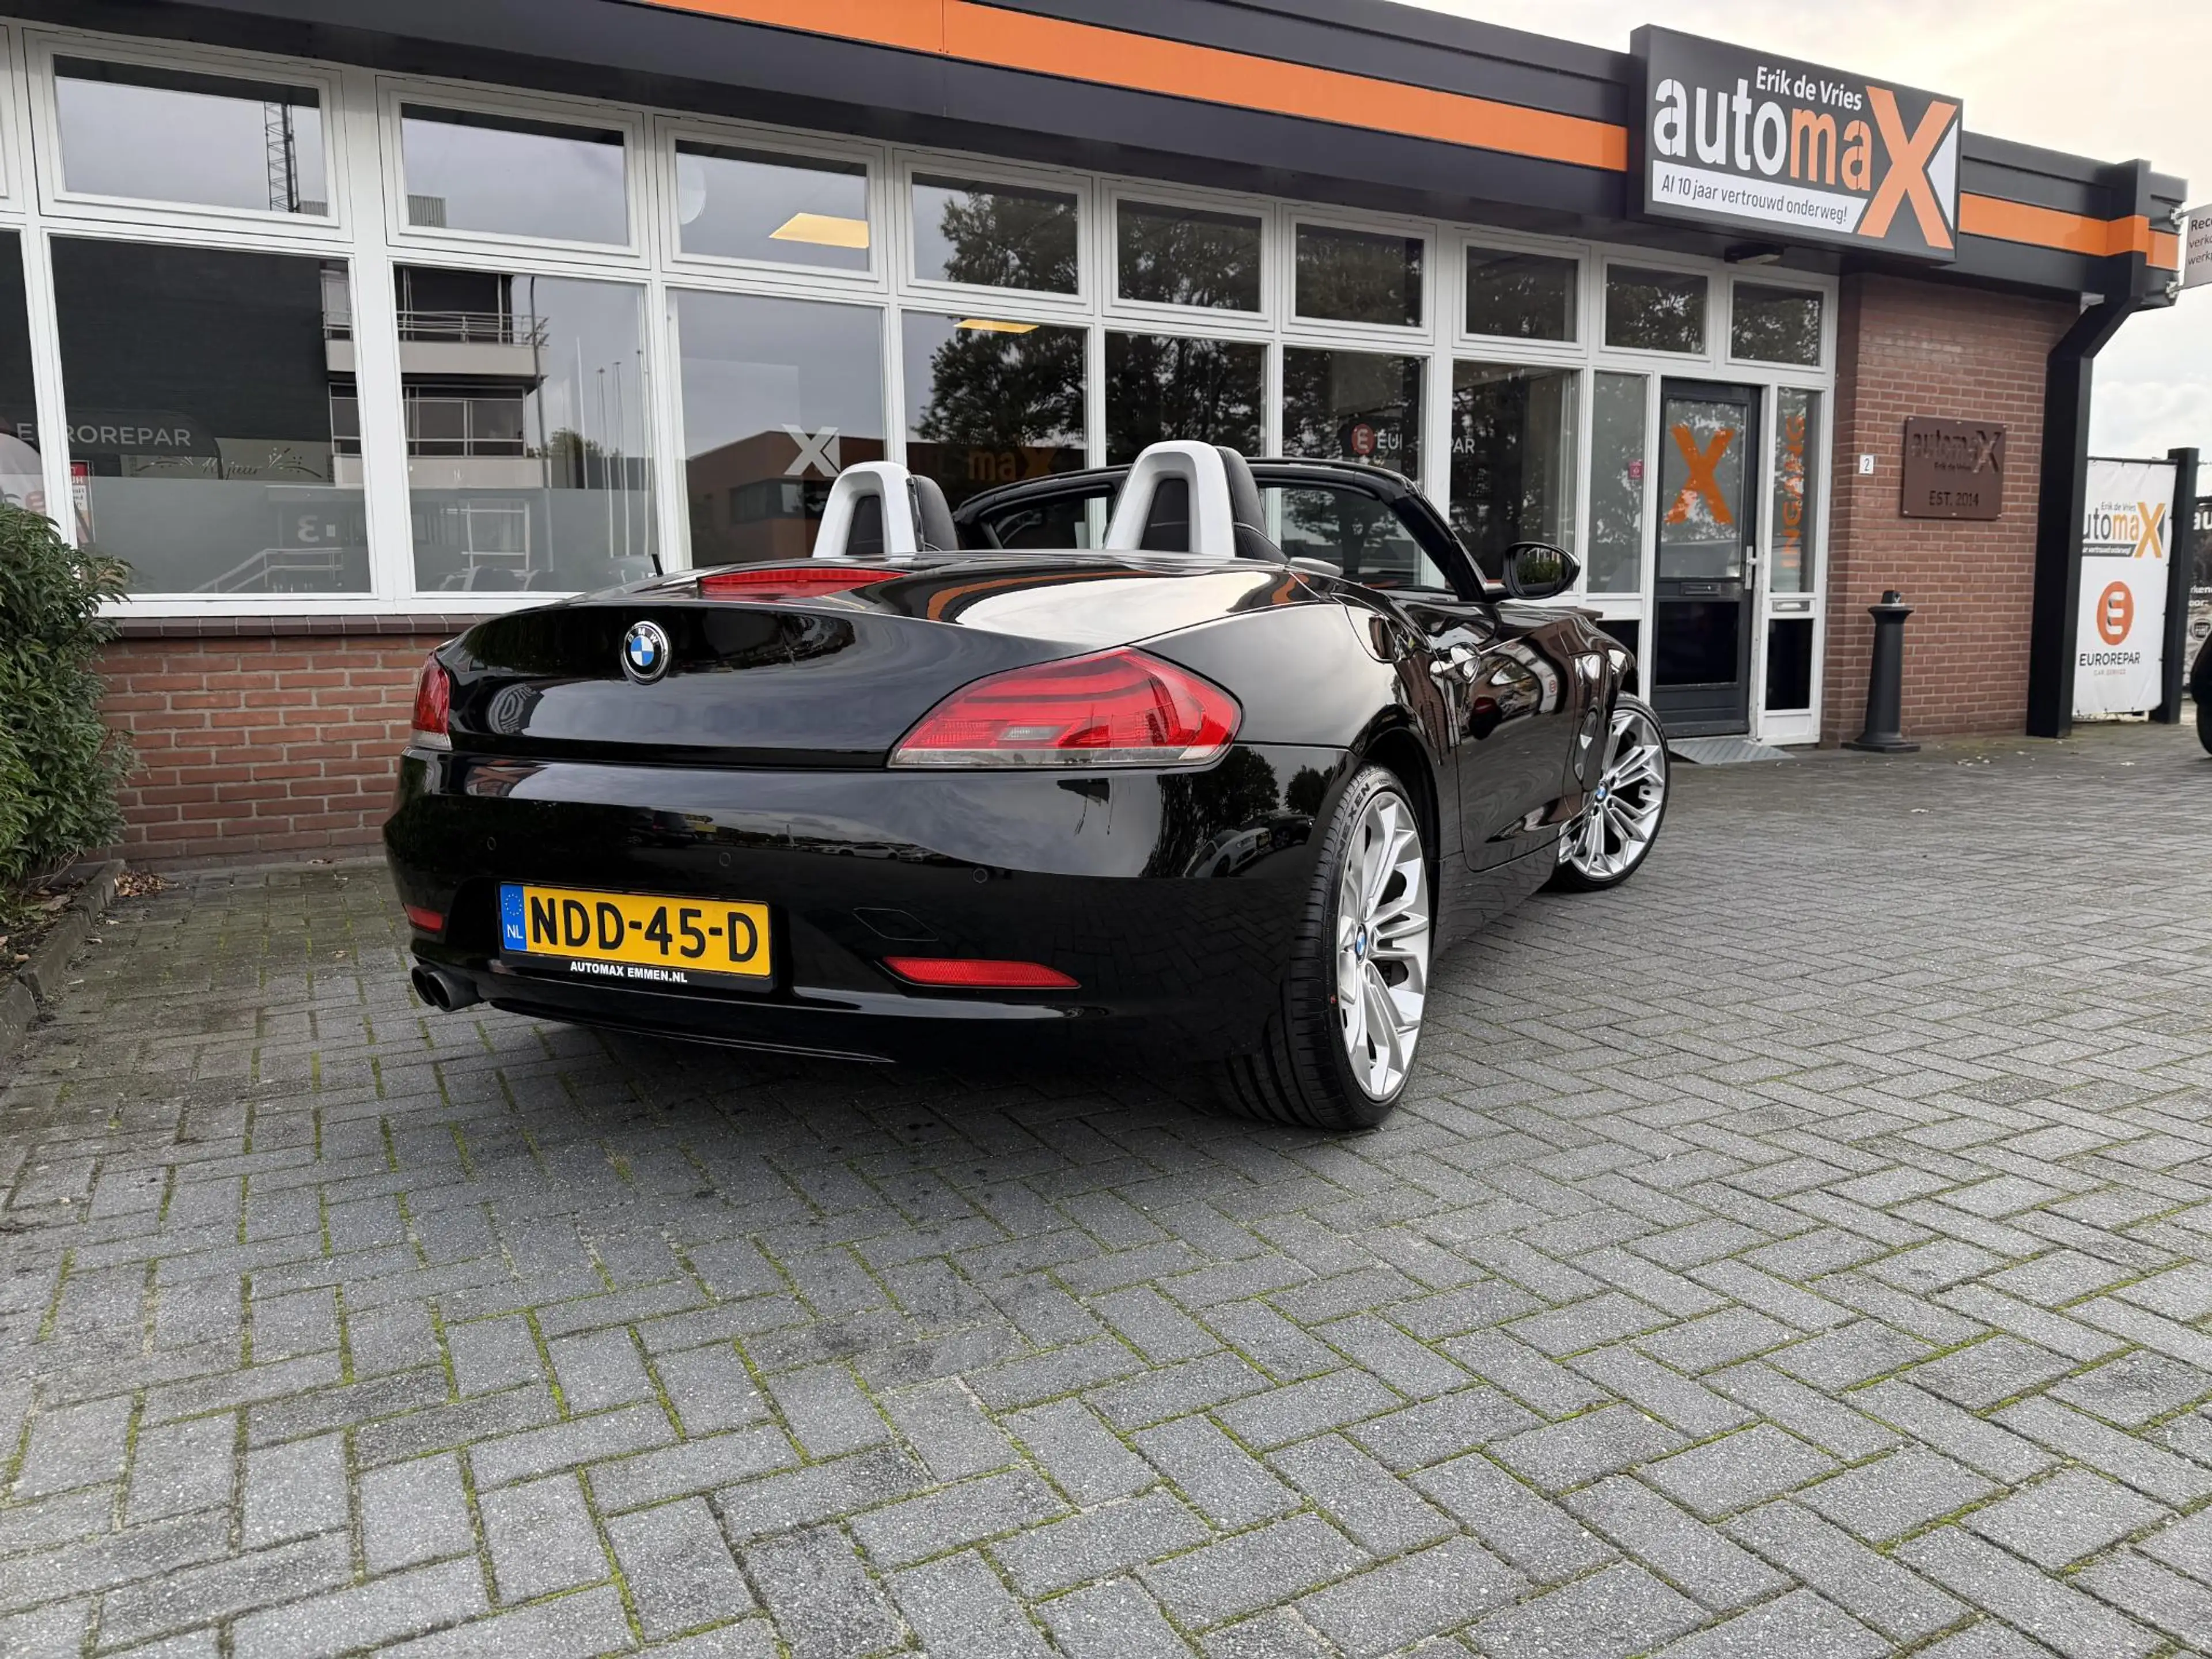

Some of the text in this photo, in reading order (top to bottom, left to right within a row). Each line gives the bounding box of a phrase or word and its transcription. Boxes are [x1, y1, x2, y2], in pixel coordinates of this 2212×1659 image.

[1757, 66, 1862, 111] Erik de Vries
[1661, 175, 1847, 224] Al 10 jaar vertrouwd onderweg!
[16, 422, 191, 447] EROREPAR
[1864, 458, 1870, 472] 2
[1929, 491, 1979, 506] EST. 2014
[627, 627, 659, 643] BMW
[2079, 652, 2141, 666] EUROREPAR
[1336, 782, 1370, 861] NEXEN
[506, 924, 524, 940] NL
[530, 896, 759, 963] NDD-45-D
[570, 961, 688, 983] AUTOMAX EMMEN.NL
